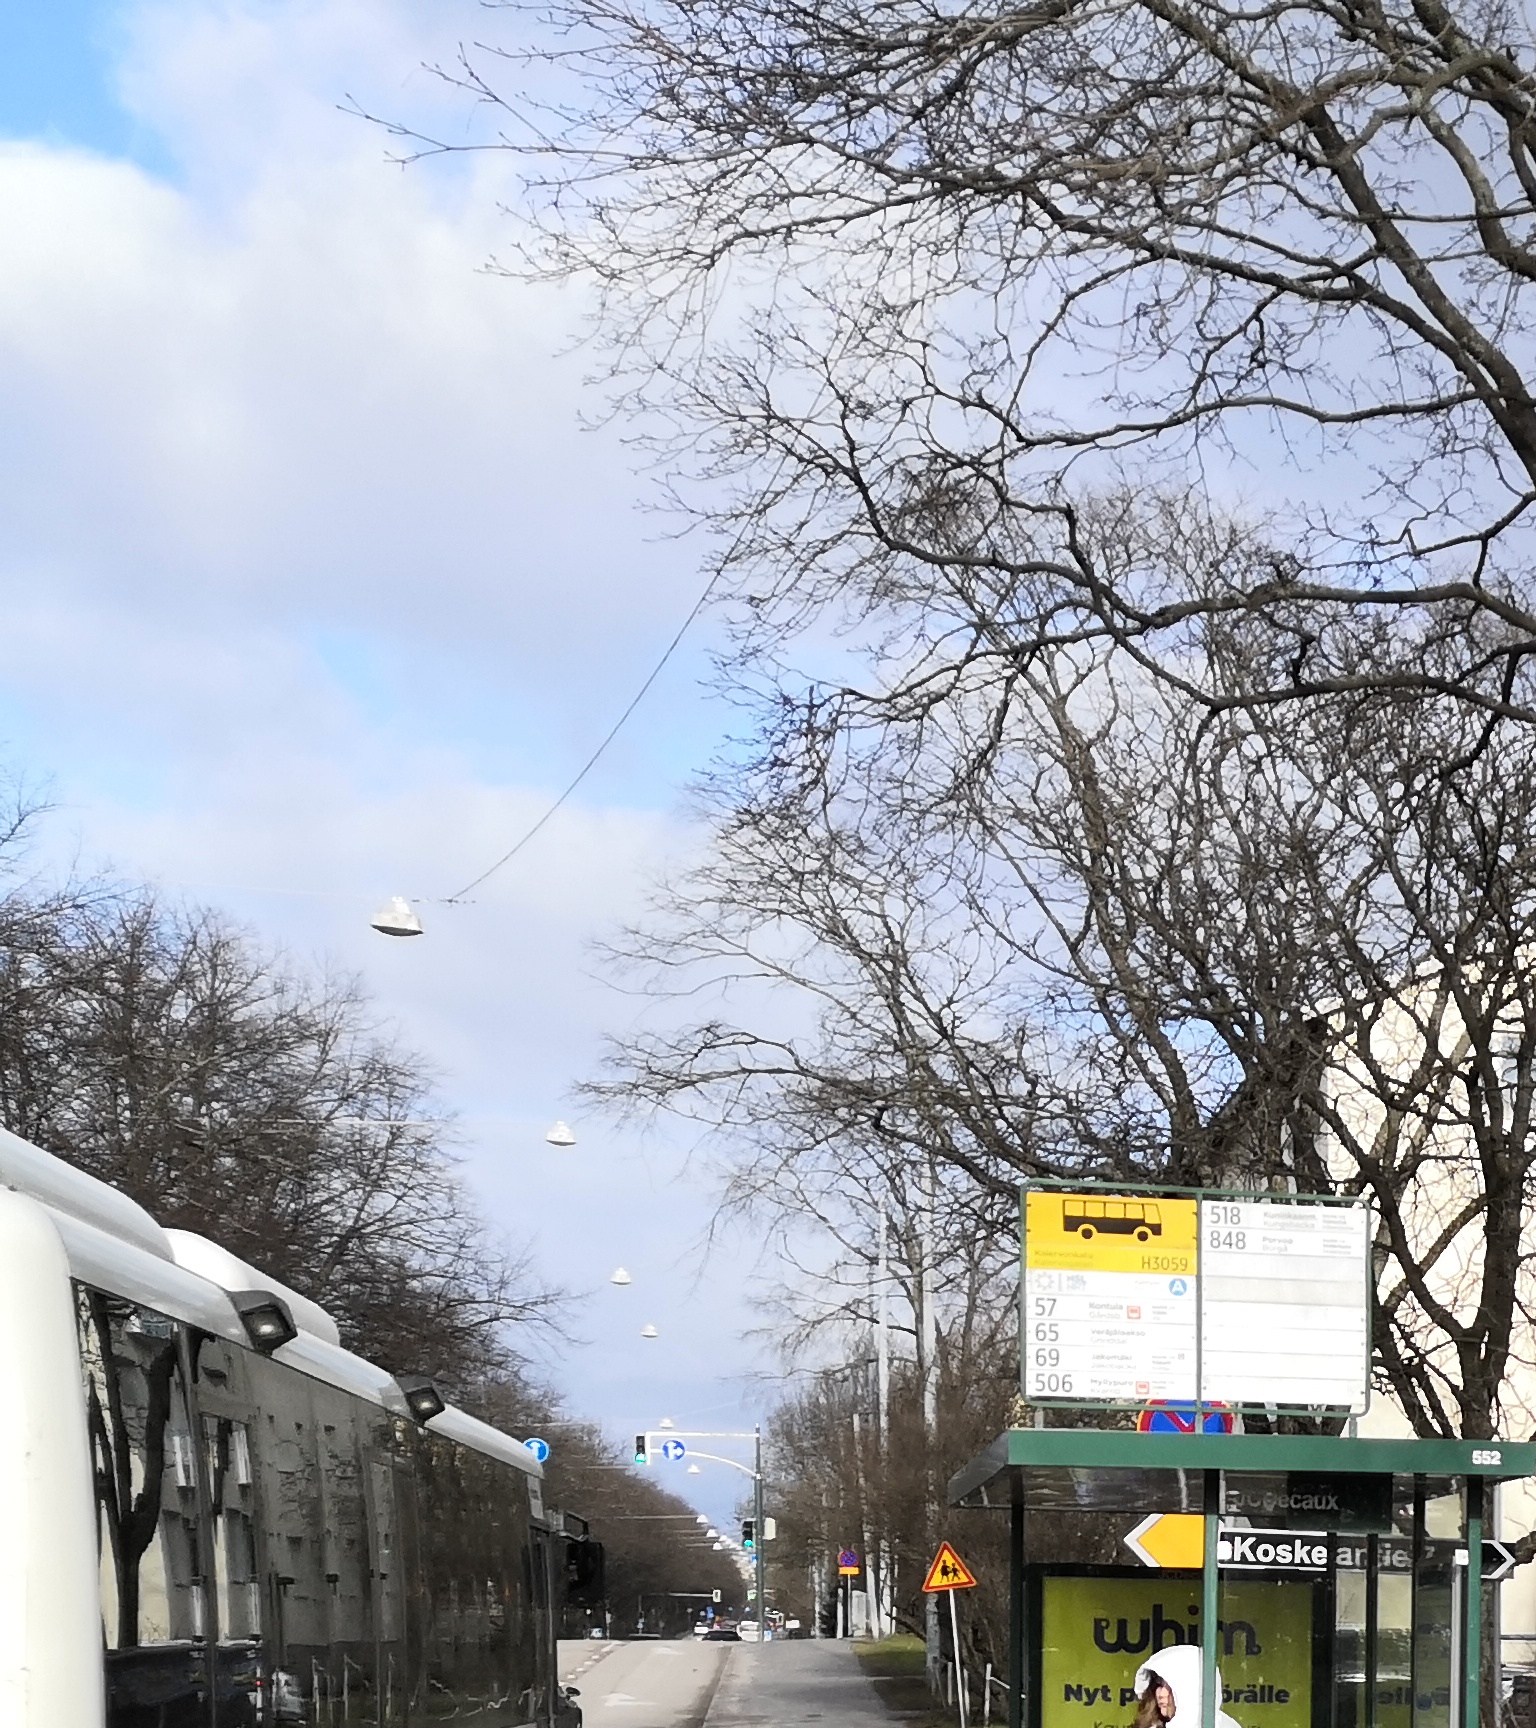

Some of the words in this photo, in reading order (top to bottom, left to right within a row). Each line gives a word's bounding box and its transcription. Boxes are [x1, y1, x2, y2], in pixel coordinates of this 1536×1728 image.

[1210, 1205, 1241, 1225] 518
[1210, 1230, 1246, 1250] 848
[1141, 1256, 1188, 1272] H3059
[1172, 1280, 1185, 1293] A
[1035, 1298, 1057, 1317] 57
[1035, 1323, 1059, 1341] 65
[1035, 1348, 1060, 1367] 69
[1035, 1373, 1073, 1392] 506
[1472, 1450, 1502, 1465] 552
[1064, 1684, 1112, 1706] Nyt
